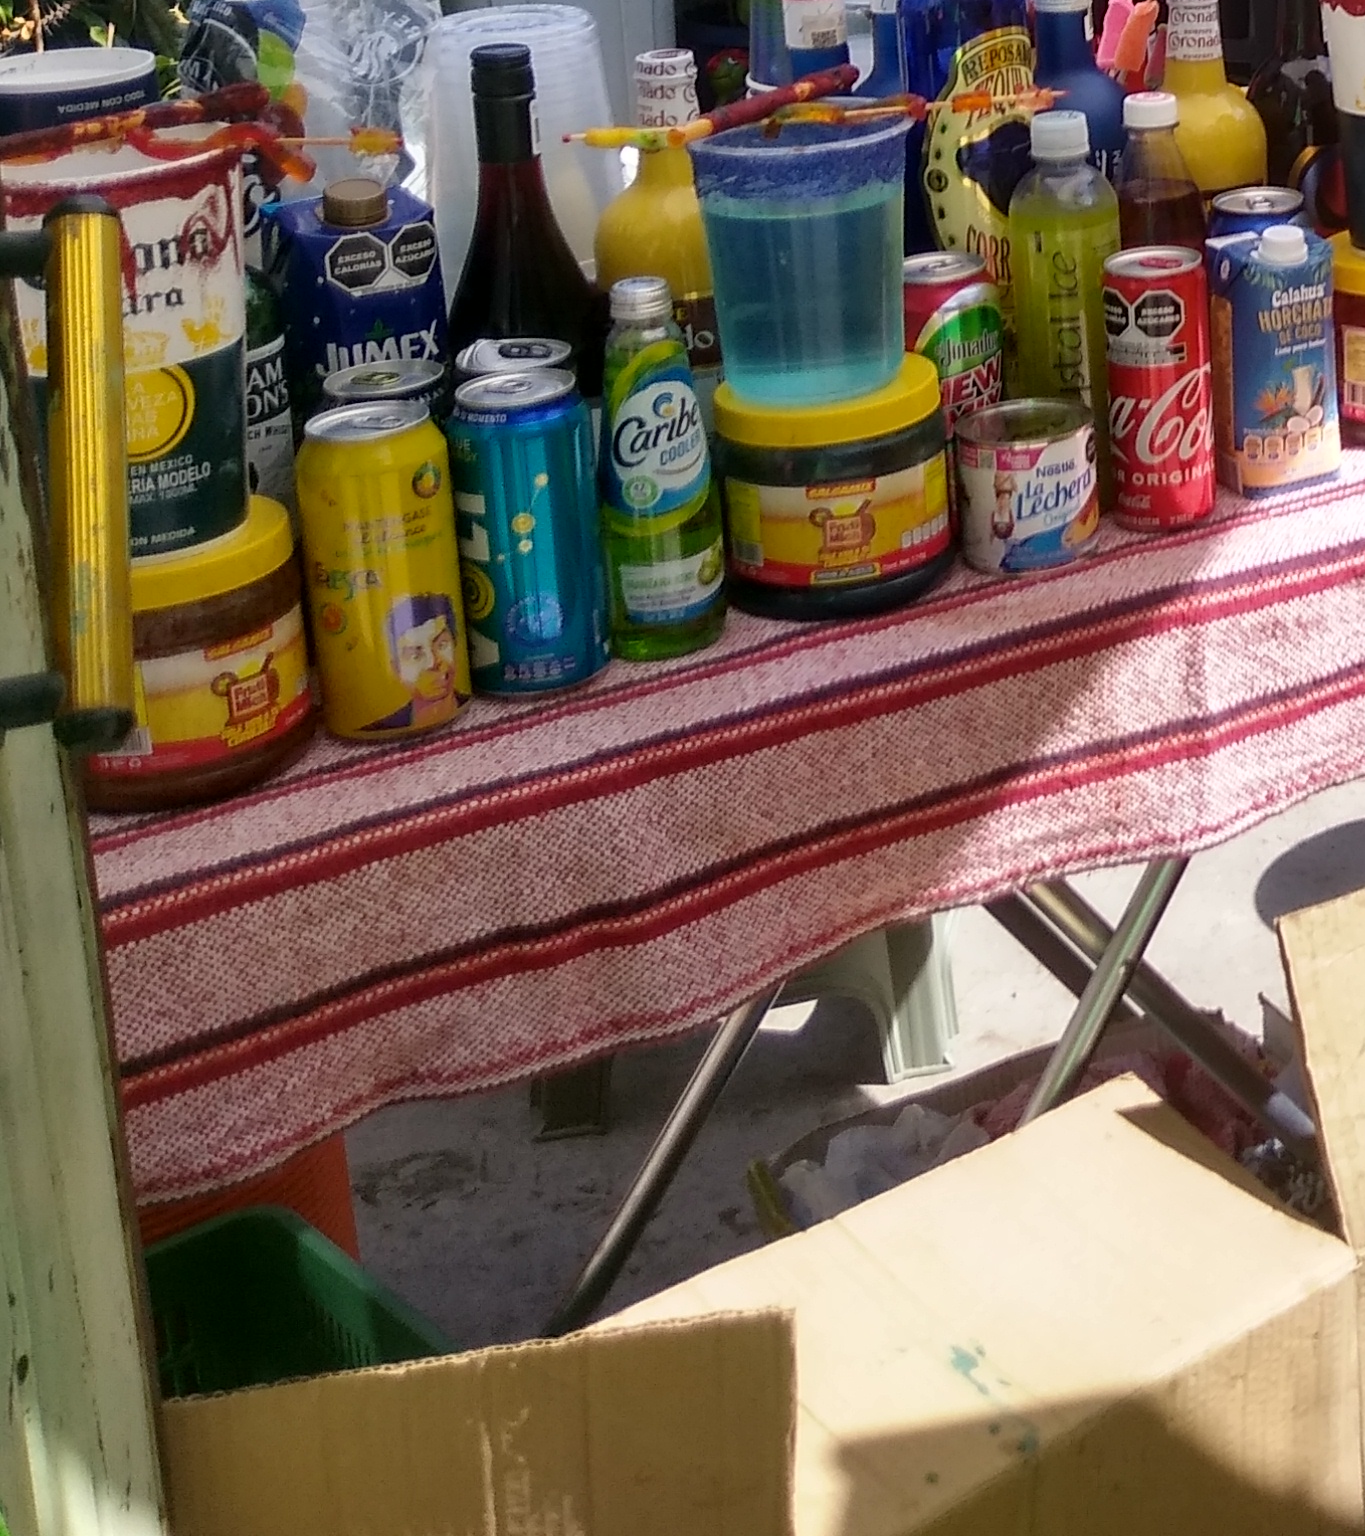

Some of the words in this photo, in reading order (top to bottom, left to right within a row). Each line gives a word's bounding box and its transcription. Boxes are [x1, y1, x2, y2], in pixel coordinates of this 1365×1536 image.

[337, 250, 377, 264] EXCESO
[399, 238, 433, 254] EXCESO
[1272, 282, 1326, 308] Calahua
[316, 318, 440, 376] JUMEX
[941, 328, 999, 367] Jimador
[613, 397, 699, 468] Caribe
[158, 461, 212, 489] MODELO
[1036, 458, 1076, 478] Nestlé
[1016, 467, 1092, 521] Lechera
[1025, 480, 1045, 499] La
[150, 524, 197, 546] MEDIDA
